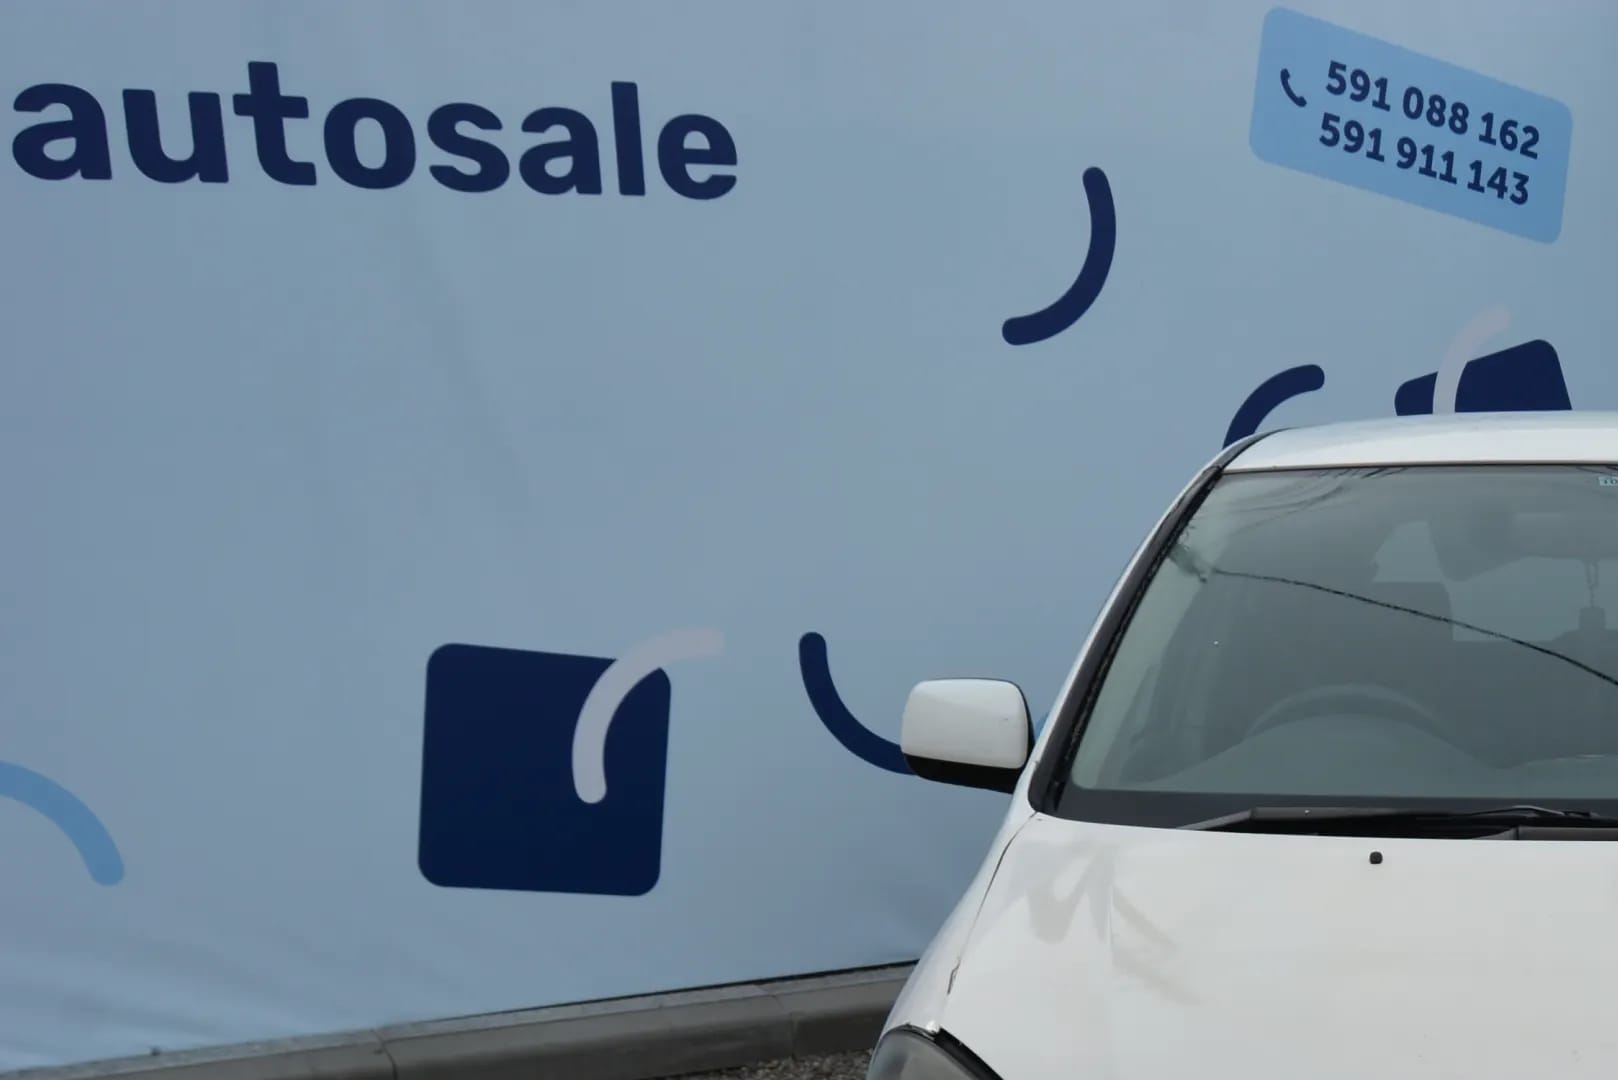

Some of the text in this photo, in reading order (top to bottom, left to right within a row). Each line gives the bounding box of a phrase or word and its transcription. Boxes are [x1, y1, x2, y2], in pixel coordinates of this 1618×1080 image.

[12, 61, 738, 200] autosale
[1319, 112, 1530, 206] 591 911 143
[1325, 60, 1540, 160] 591 088 162
